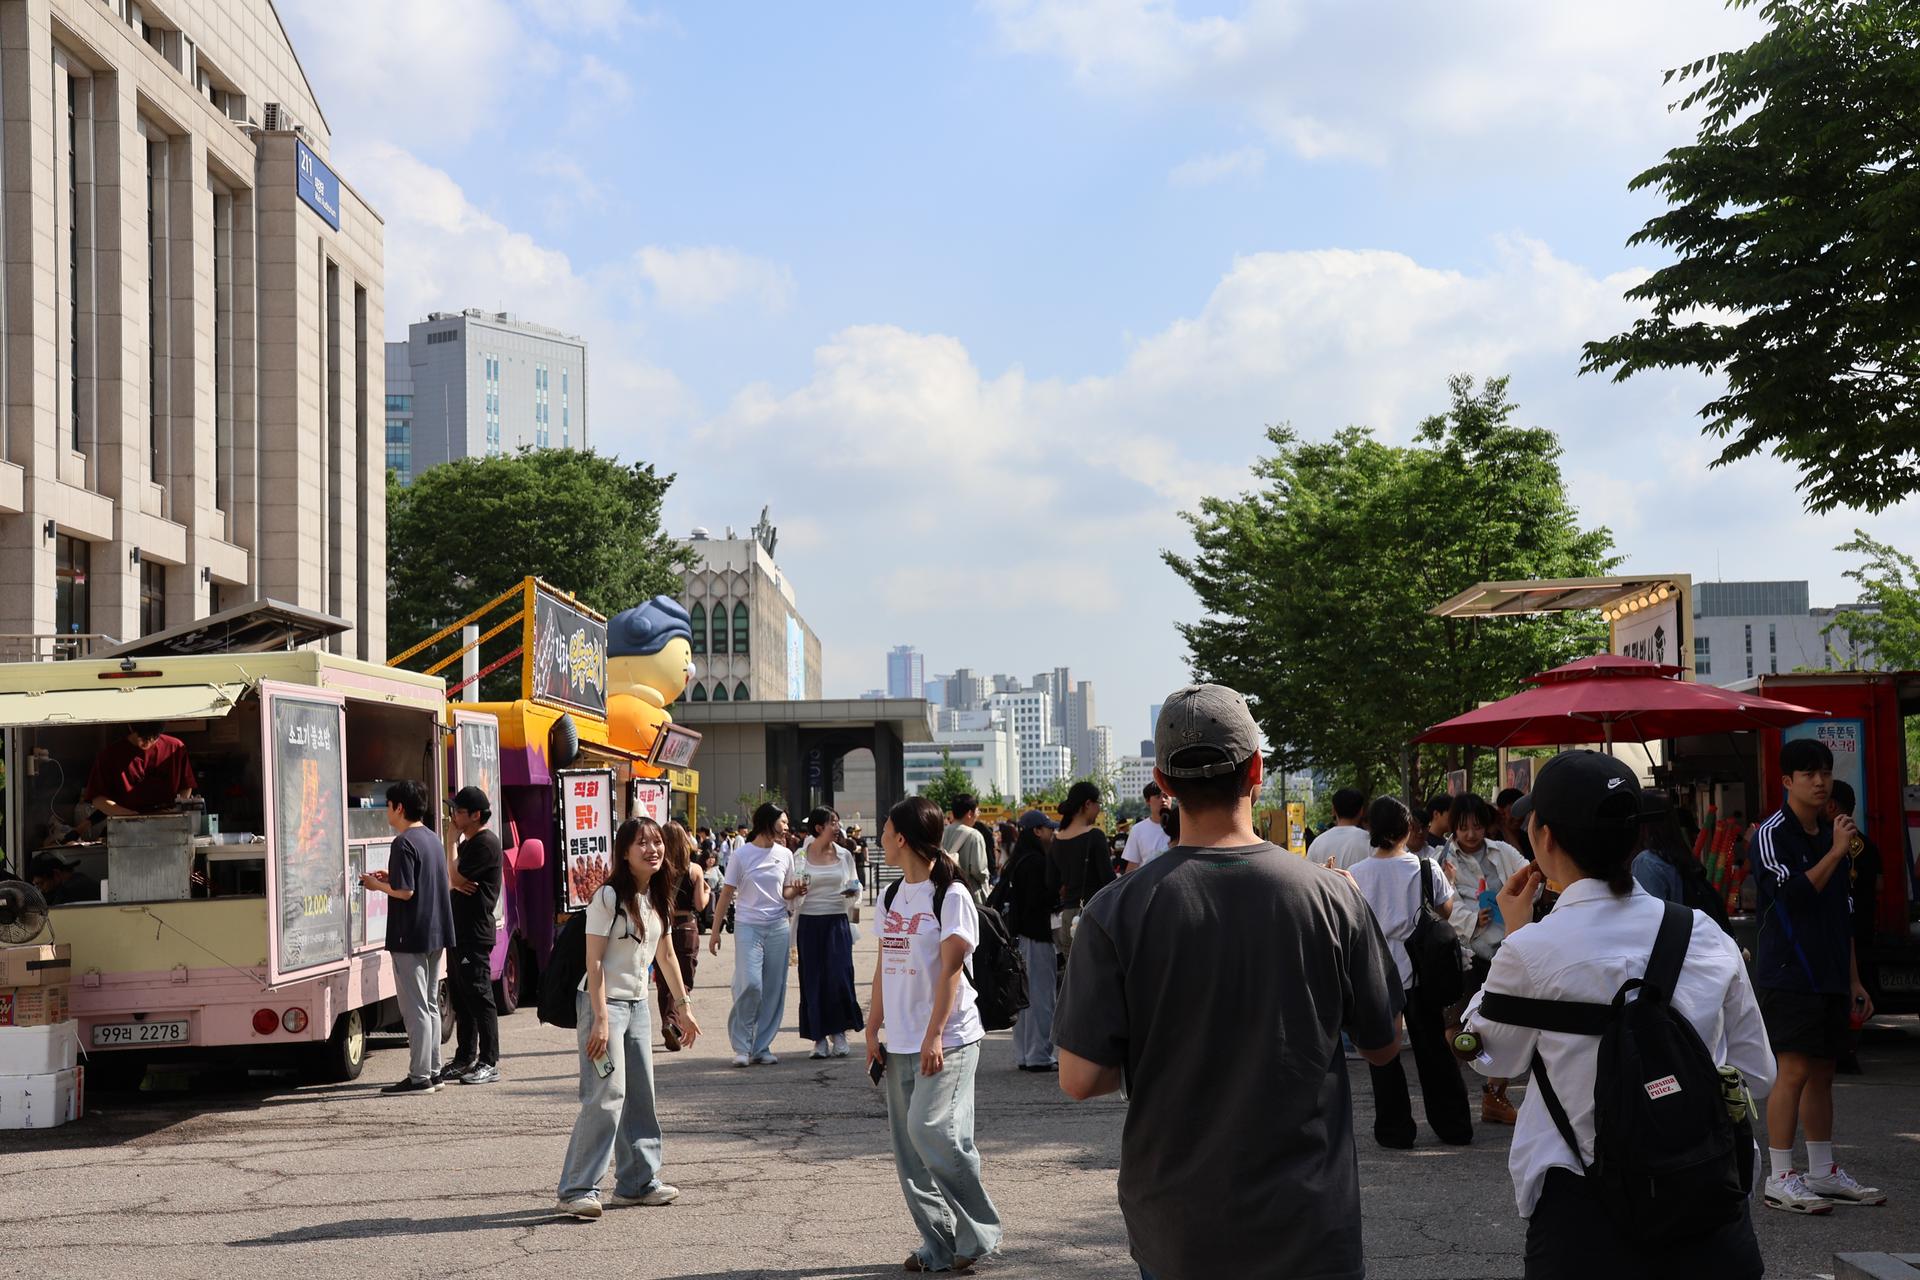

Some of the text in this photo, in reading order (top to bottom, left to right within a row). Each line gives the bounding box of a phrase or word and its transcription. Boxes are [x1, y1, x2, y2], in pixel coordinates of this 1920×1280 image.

[301, 150, 312, 177] 211
[288, 722, 310, 748] 소고기
[1817, 726, 1856, 739] 쫀득쫀득
[574, 781, 599, 798] 직화
[575, 805, 598, 830] 닭!
[570, 836, 607, 855] 염통구이
[102, 1024, 180, 1042] 99러 2278
[1650, 1086, 1674, 1097] rulez.
